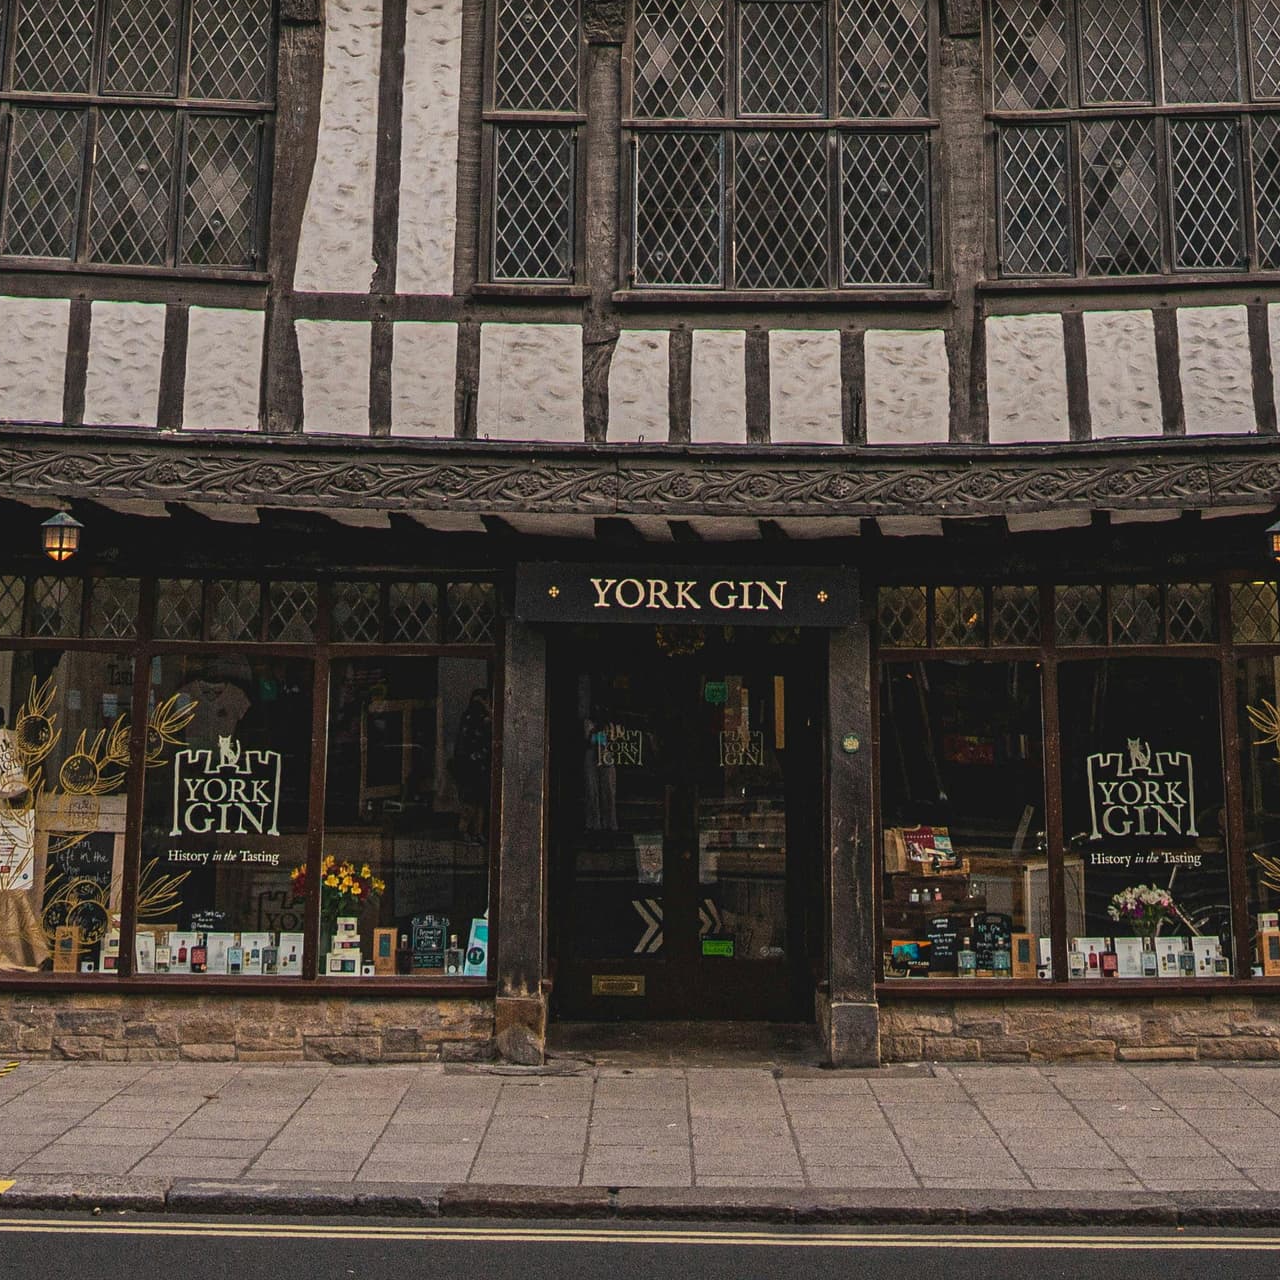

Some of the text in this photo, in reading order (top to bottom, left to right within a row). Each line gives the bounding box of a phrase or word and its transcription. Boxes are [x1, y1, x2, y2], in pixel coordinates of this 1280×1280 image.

[590, 578, 787, 610] YORK GIN
[184, 778, 271, 803] YORK
[1097, 781, 1187, 805] YORK
[184, 802, 269, 834] GIN
[1103, 804, 1185, 836] GIN
[168, 850, 280, 866] History in the Tasting
[1091, 852, 1202, 867] History in the Tasting
